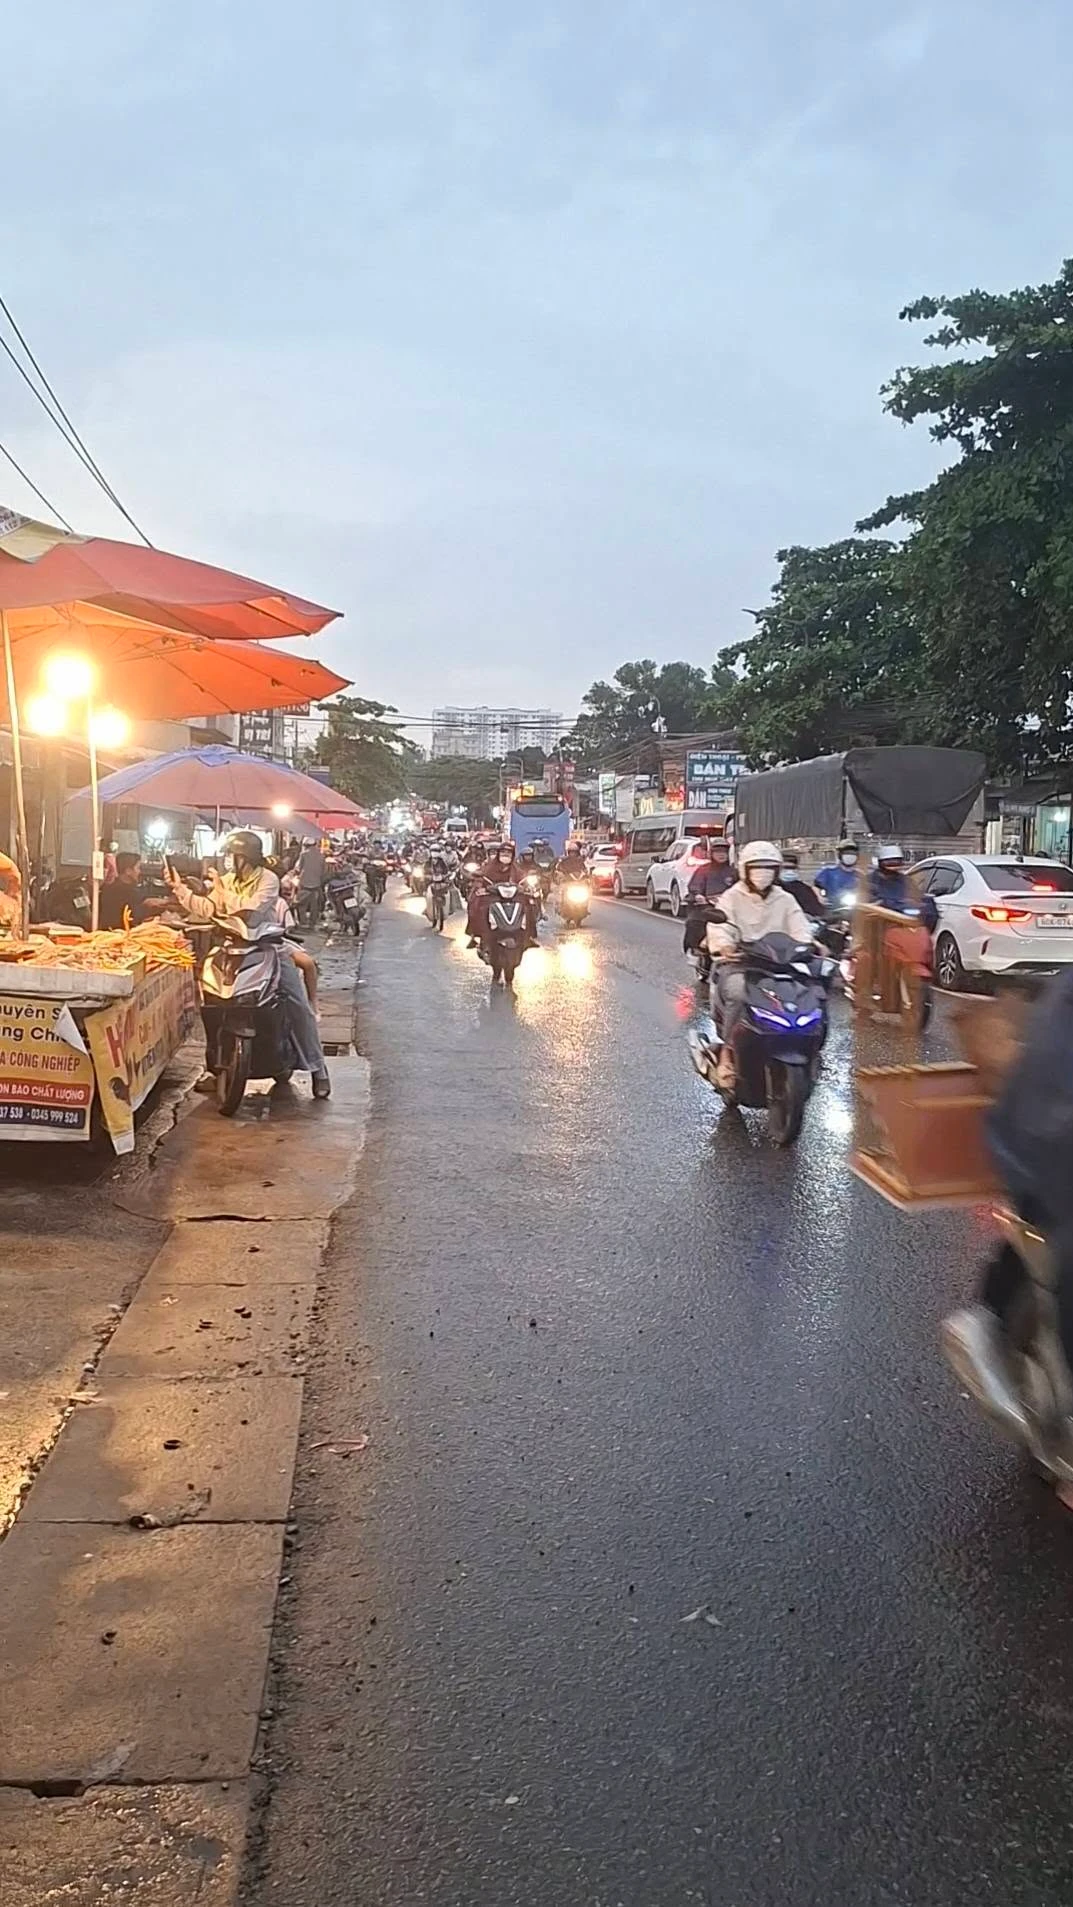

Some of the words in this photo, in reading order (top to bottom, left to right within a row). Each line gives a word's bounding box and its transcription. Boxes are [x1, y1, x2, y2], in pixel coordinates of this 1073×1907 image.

[9, 1049, 39, 1069] CÔNG
[41, 1054, 81, 1074] NGHIỆP
[31, 1084, 55, 1098] CHẤT
[55, 1089, 85, 1101] LƯỢNG
